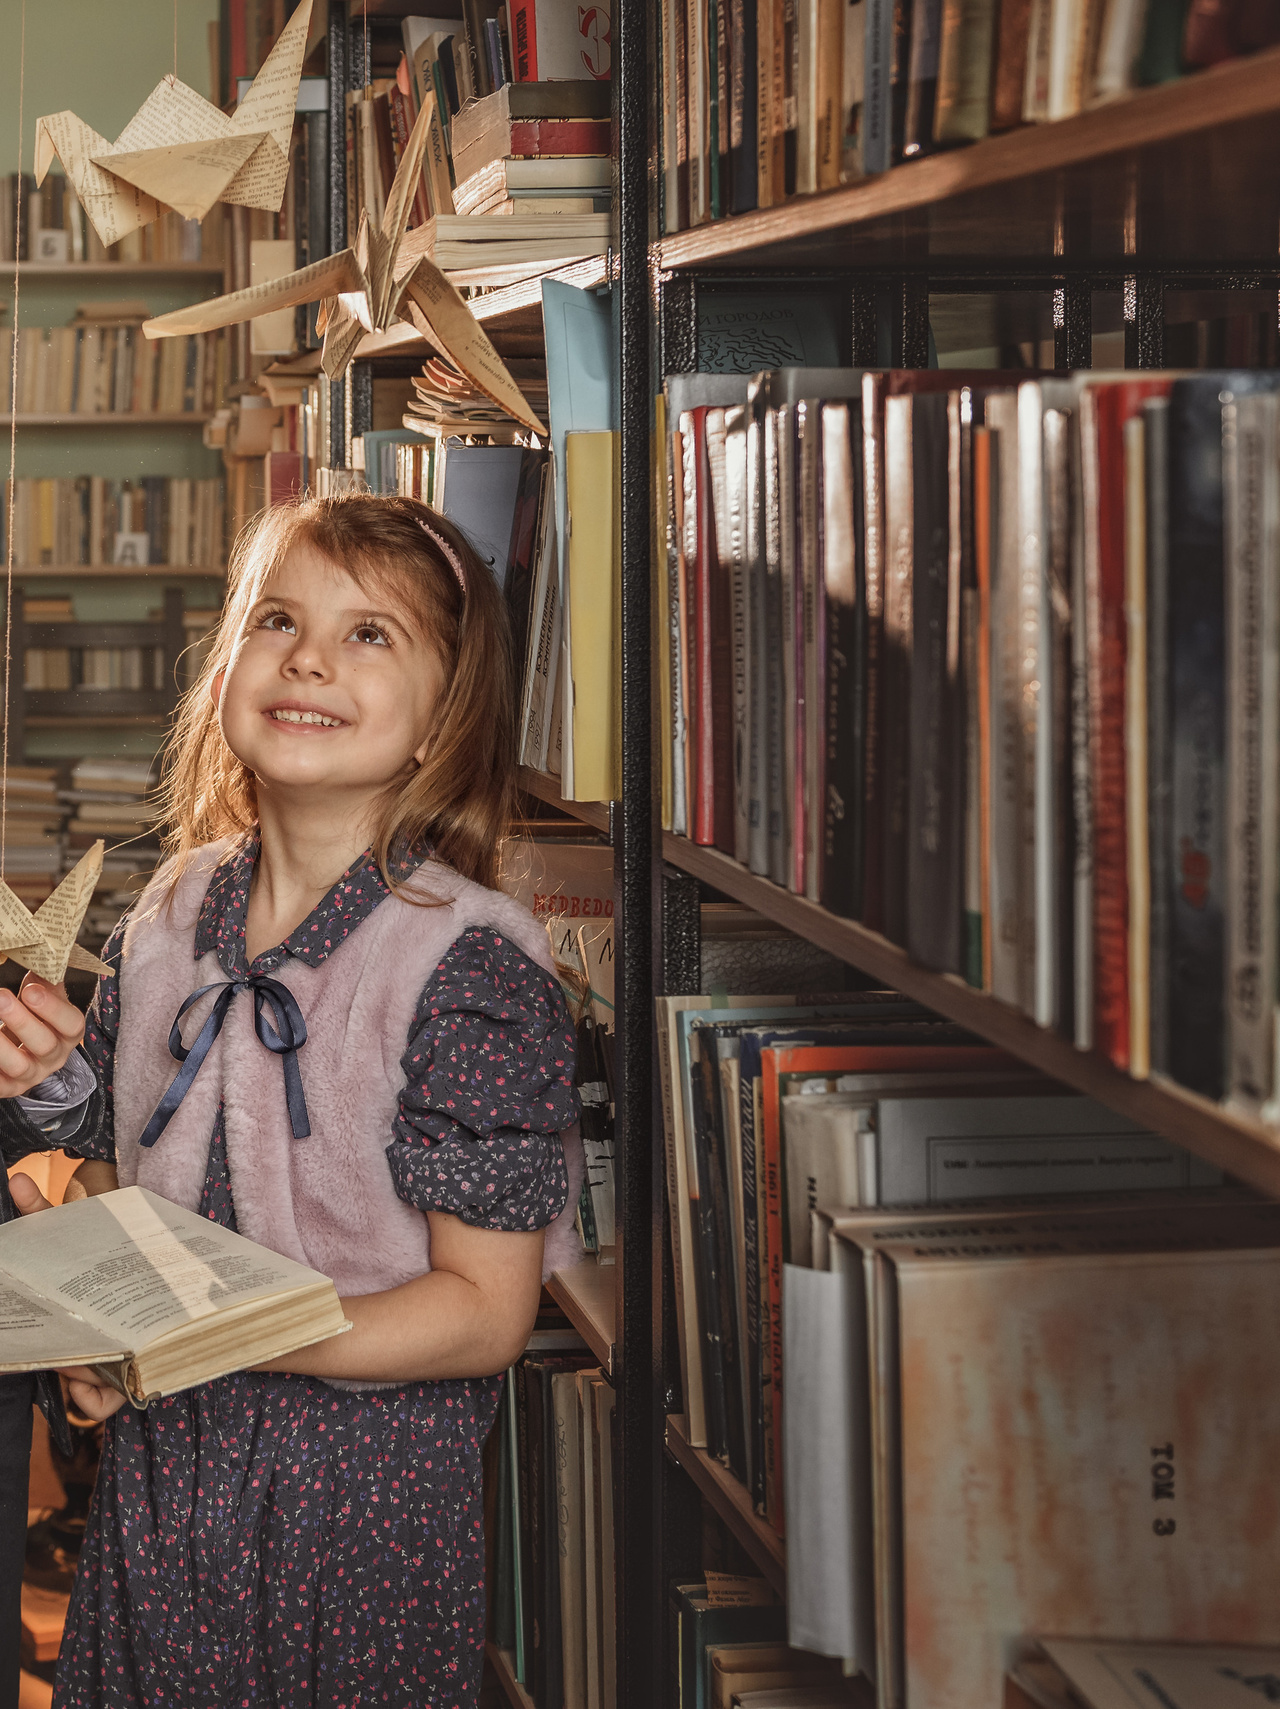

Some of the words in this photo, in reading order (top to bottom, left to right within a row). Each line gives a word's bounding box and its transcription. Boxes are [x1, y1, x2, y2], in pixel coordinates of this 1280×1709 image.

[715, 308, 794, 323] ГОРОДОВ
[1150, 1440, 1175, 1501] ТОМ
[1151, 1517, 1176, 1536] 3
